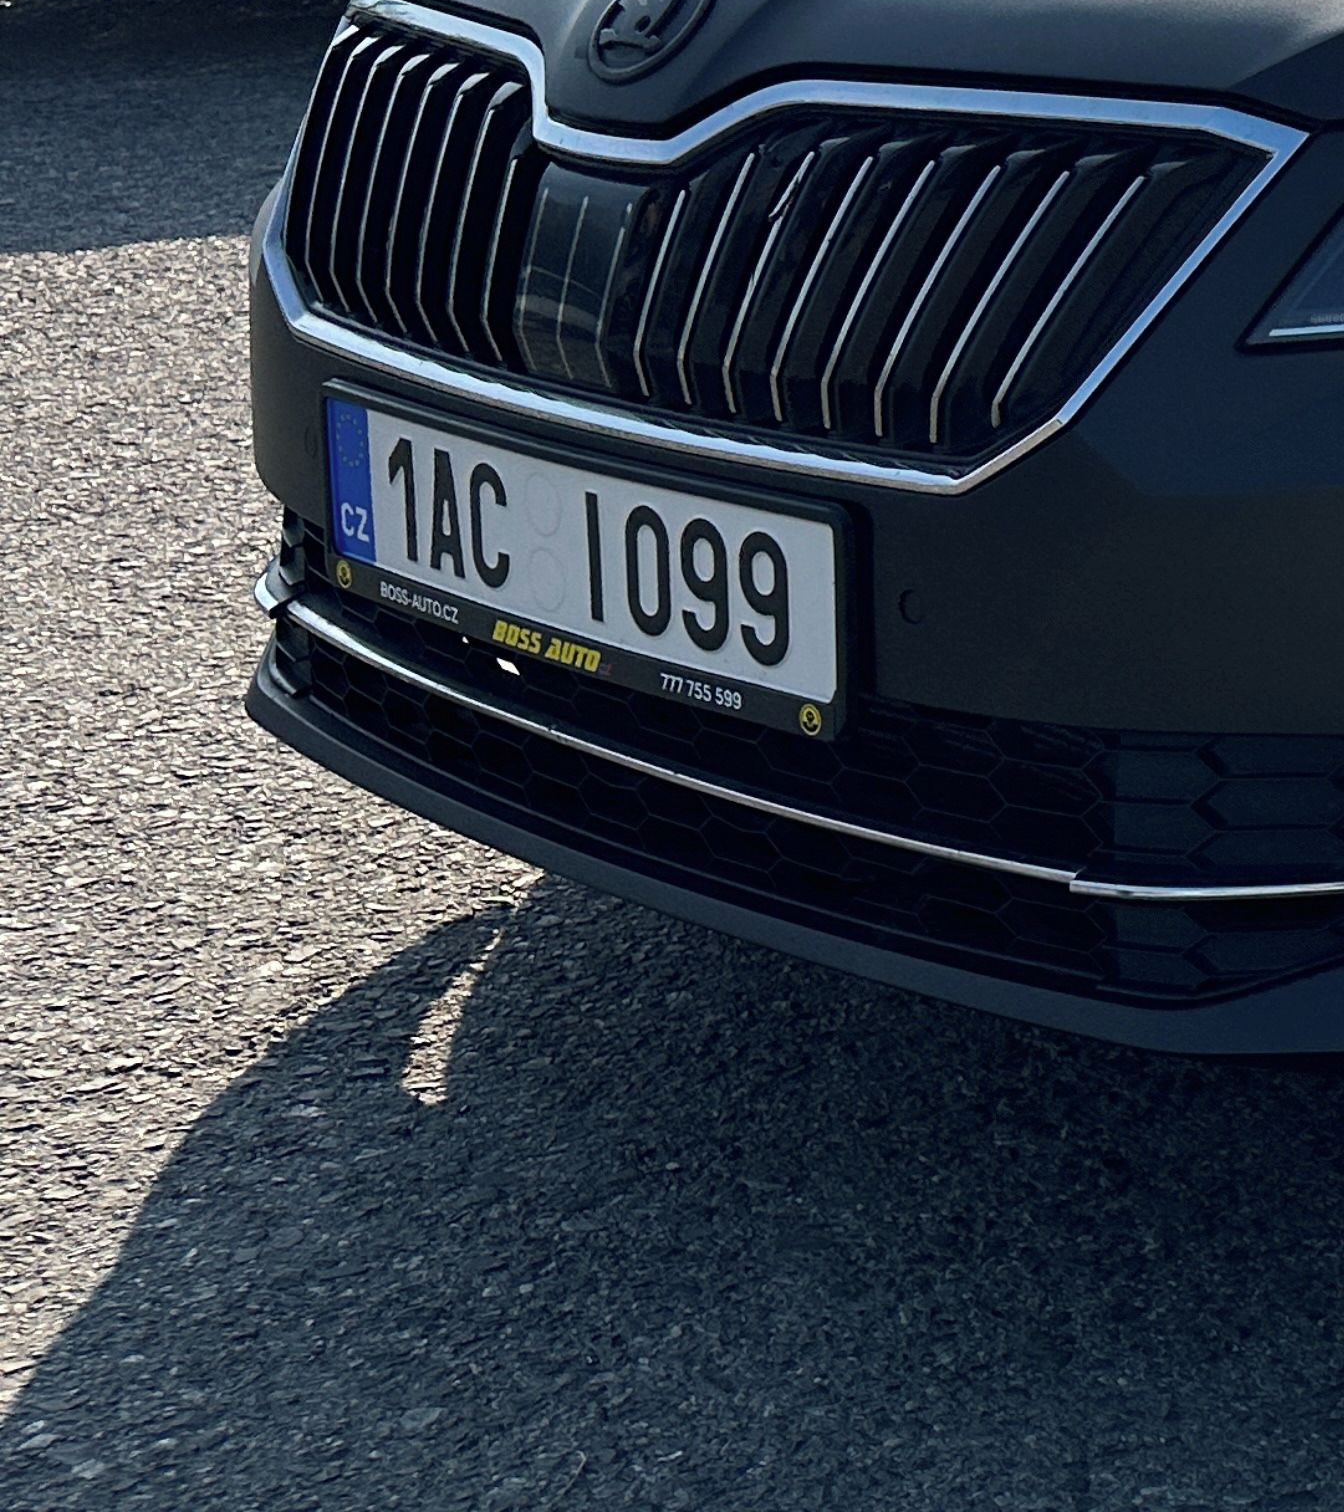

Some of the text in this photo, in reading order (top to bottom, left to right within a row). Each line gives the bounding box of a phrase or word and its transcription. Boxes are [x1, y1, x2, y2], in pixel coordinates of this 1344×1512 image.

[340, 501, 370, 543] CZ
[388, 438, 510, 588] 1AC
[379, 580, 460, 625] BOSS-AUTO.CZ
[492, 619, 542, 654] BOSS
[544, 638, 601, 672] AUTO
[660, 672, 742, 710] 777 755 599
